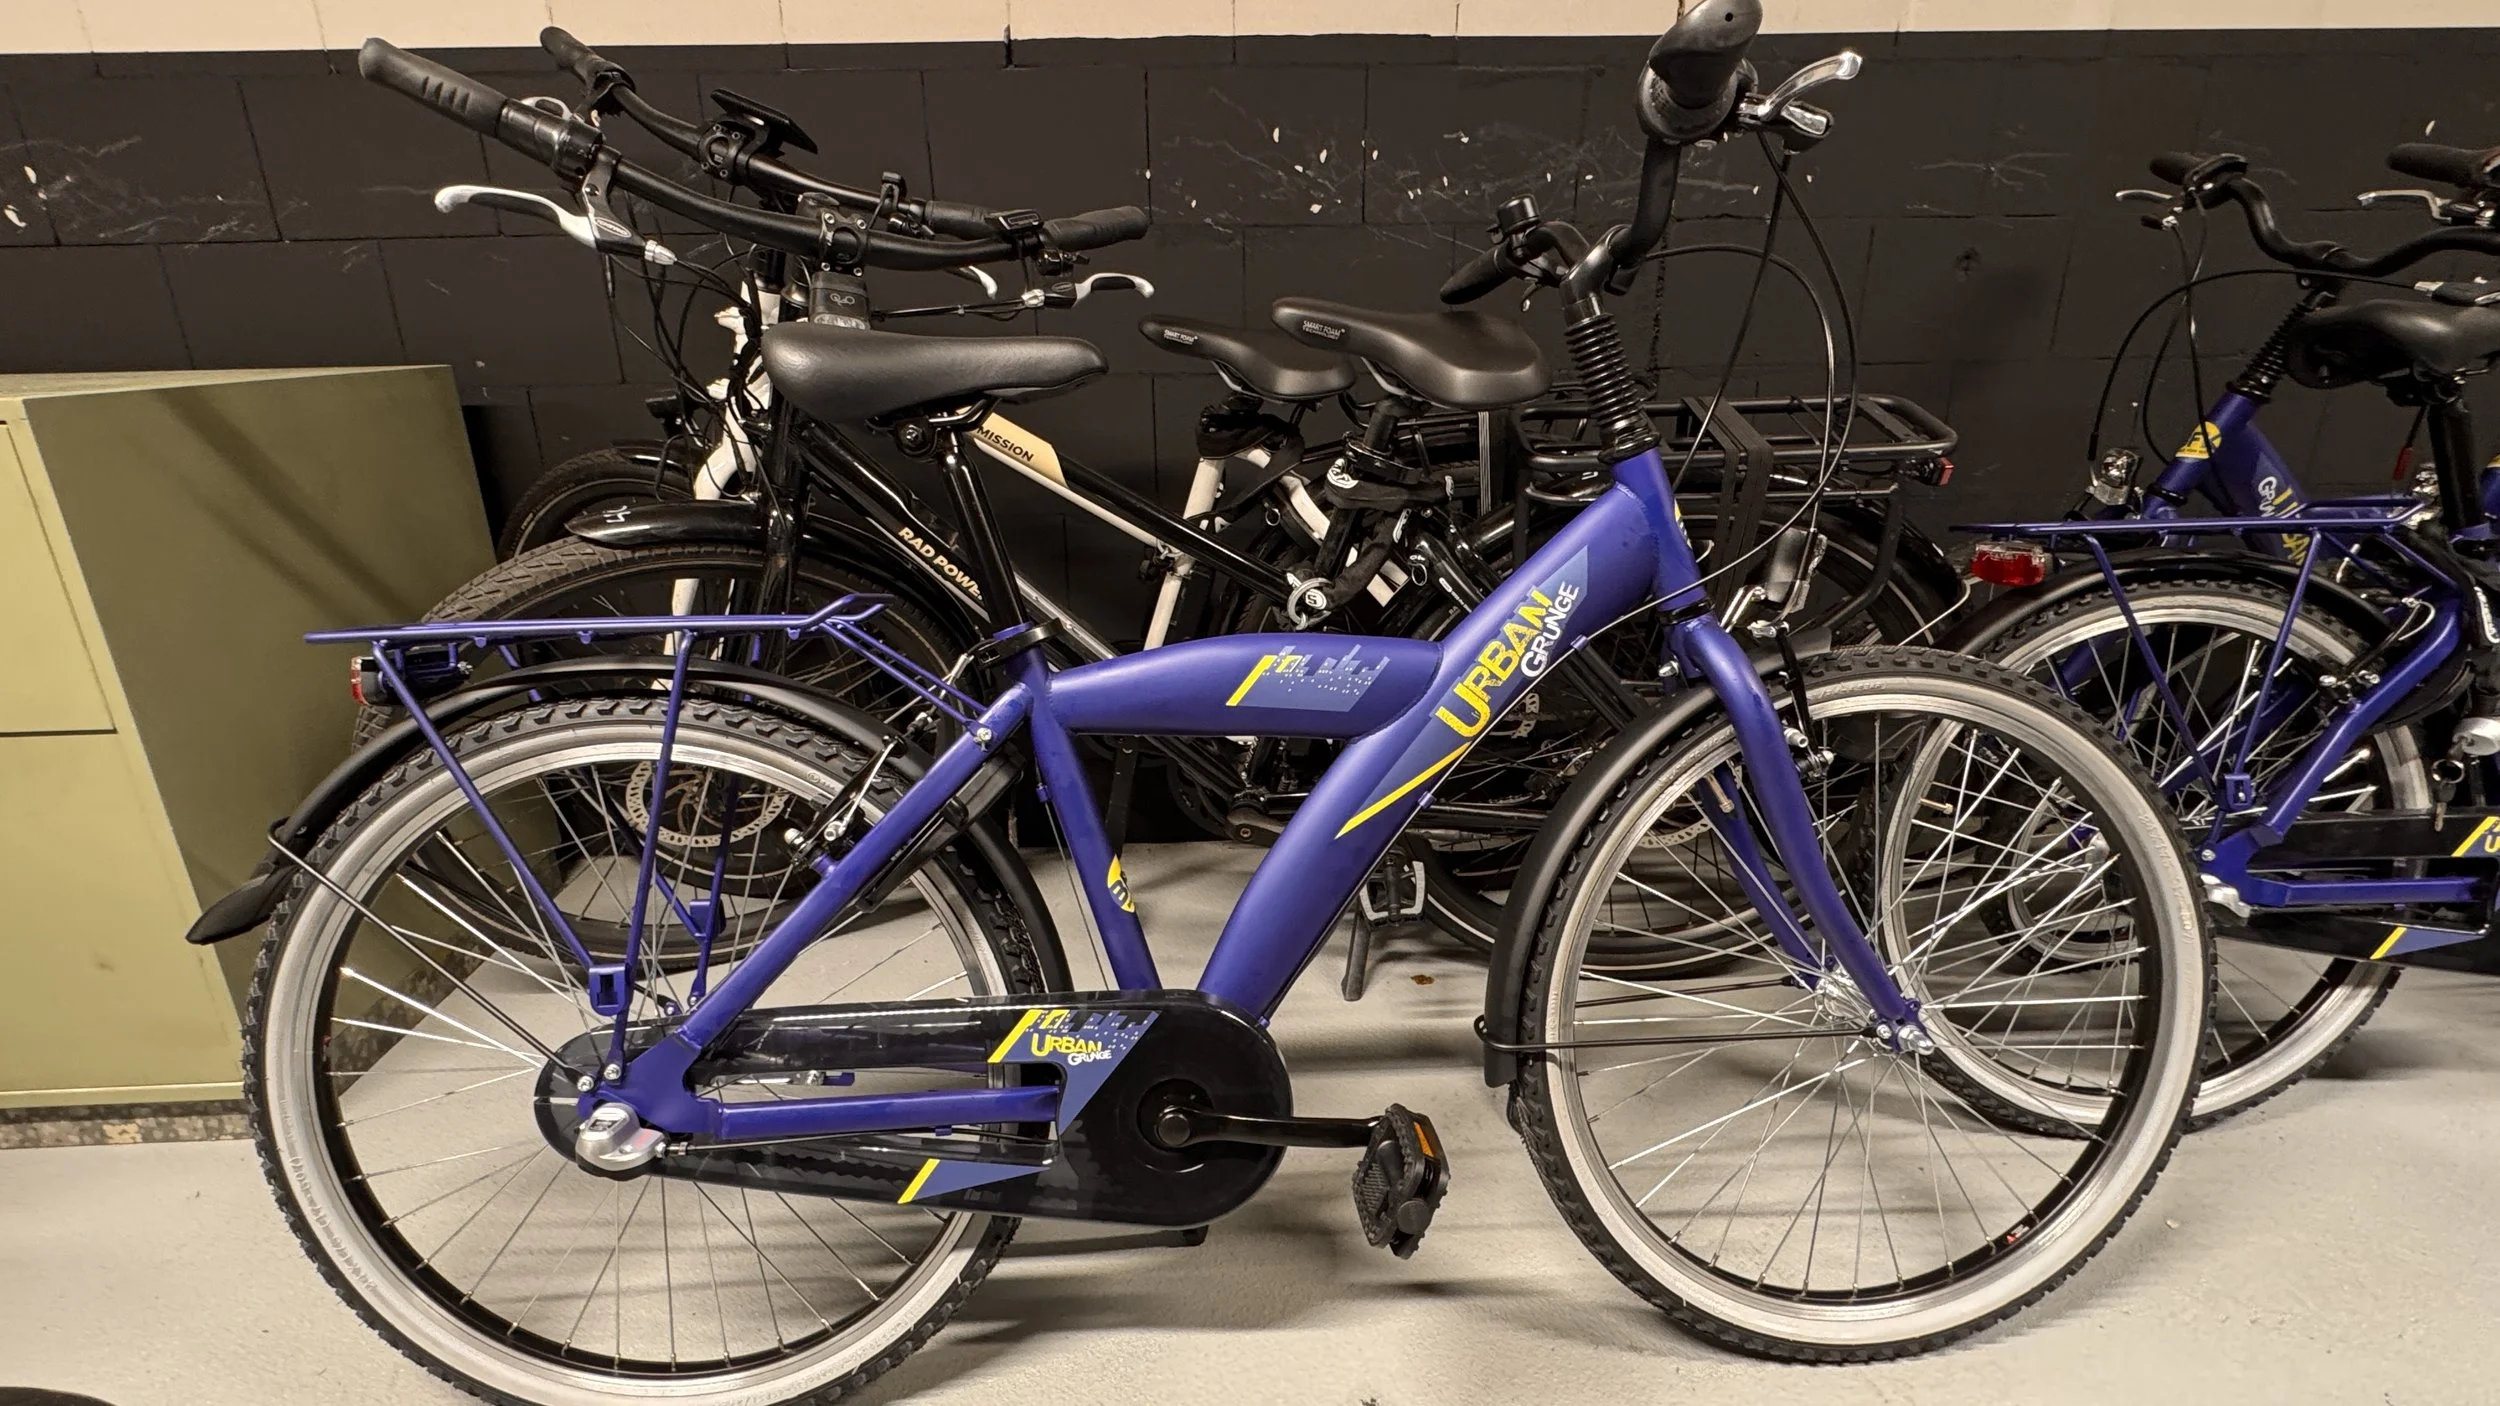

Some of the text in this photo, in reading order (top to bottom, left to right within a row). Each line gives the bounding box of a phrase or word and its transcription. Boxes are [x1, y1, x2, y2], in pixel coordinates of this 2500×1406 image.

[977, 427, 1034, 462] MISSION
[2257, 476, 2278, 518] GRUN
[898, 527, 983, 600] RAD POWE
[1520, 581, 1580, 678] GRUNGE
[1435, 589, 1553, 738] URBAN
[1031, 1033, 1103, 1057] URBAN
[1067, 1049, 1112, 1066] GRUNGE
